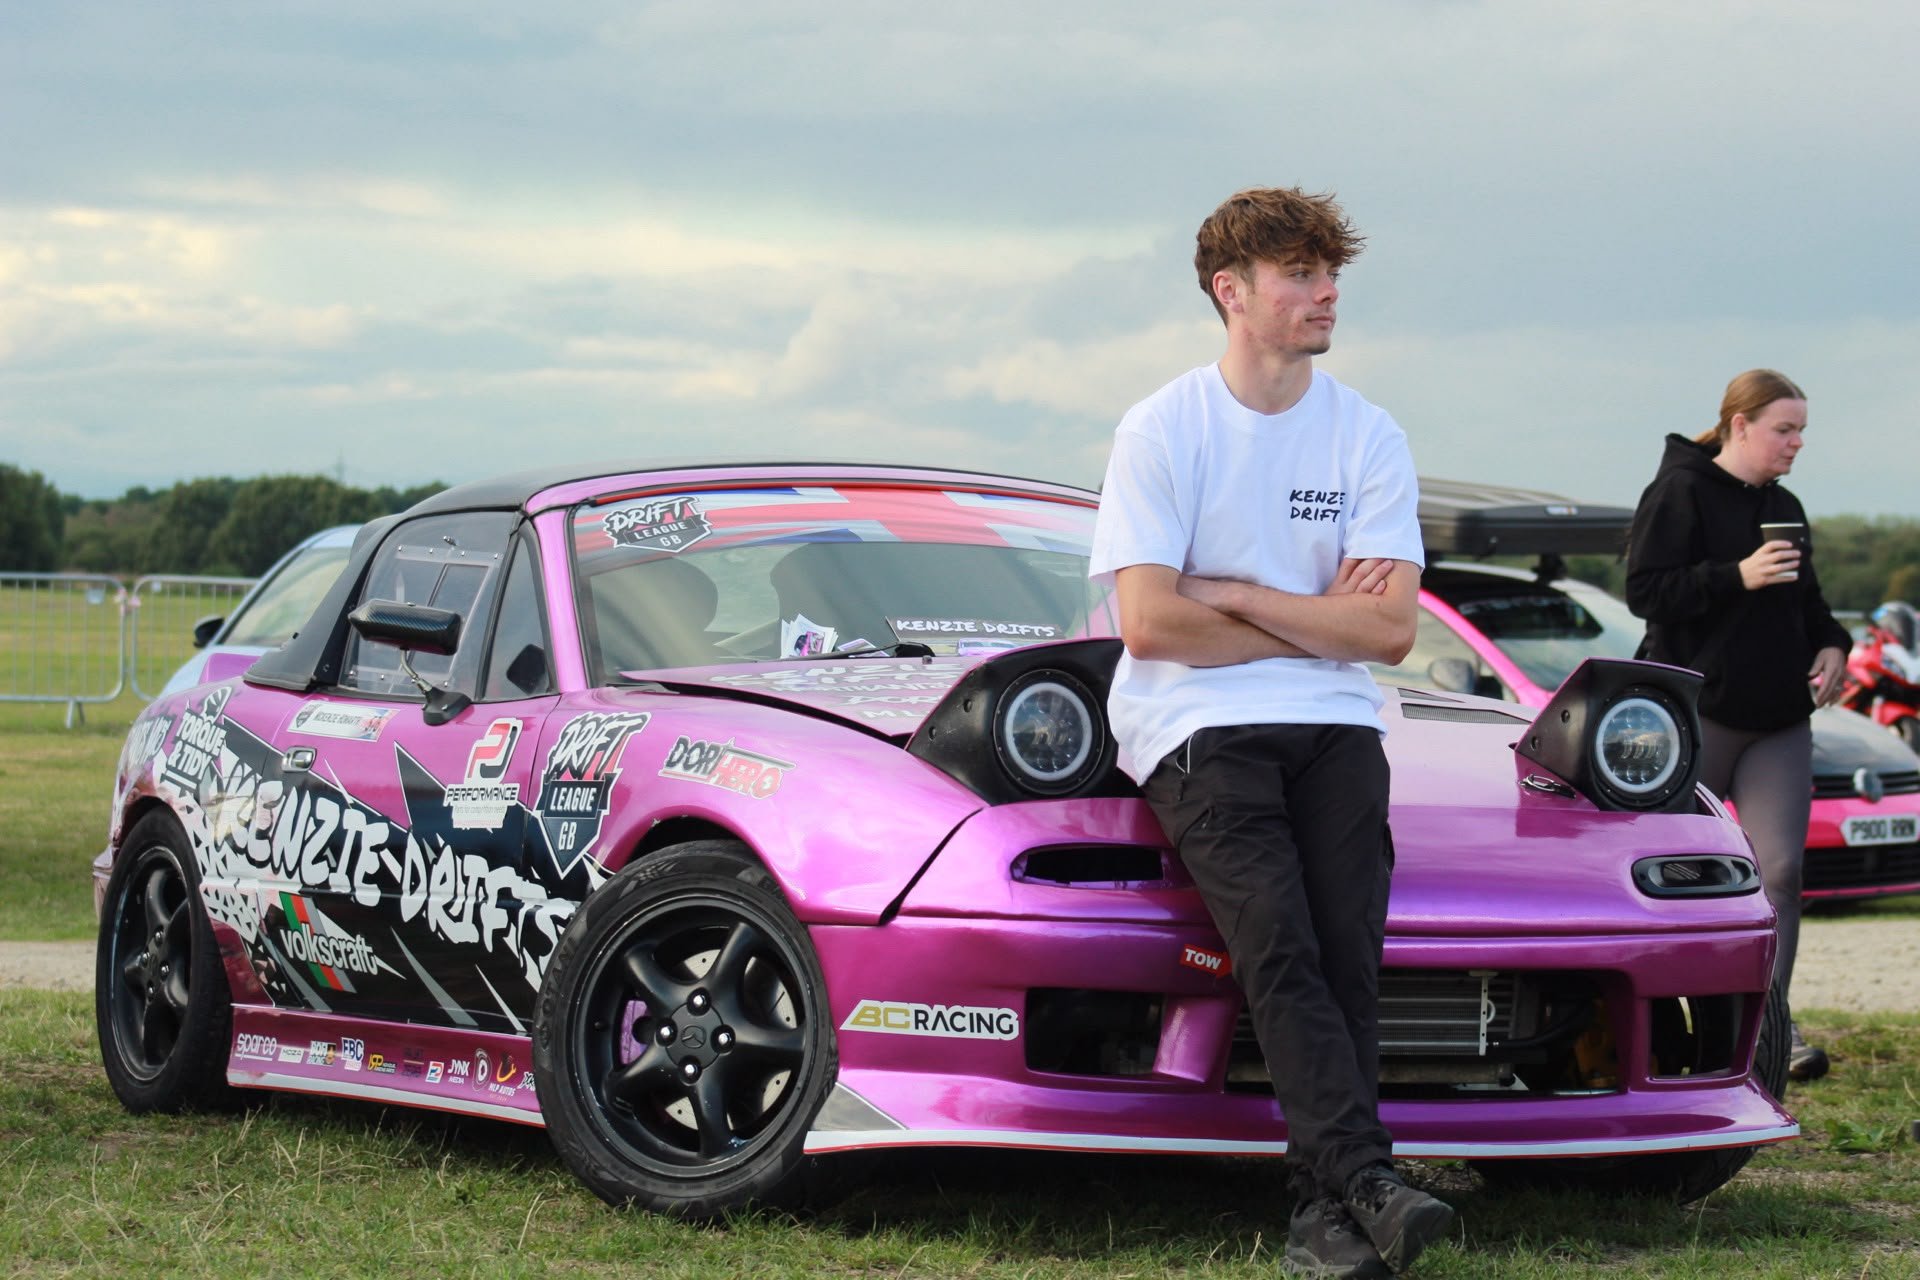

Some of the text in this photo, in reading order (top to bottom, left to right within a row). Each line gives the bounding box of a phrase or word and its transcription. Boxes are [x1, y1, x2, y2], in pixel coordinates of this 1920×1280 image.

[608, 498, 691, 534] DRIFT
[633, 521, 688, 540] LEAGUE
[660, 534, 682, 547] GB
[896, 619, 1055, 637] KENZIE DRIFTS
[176, 711, 227, 757] TORQUE
[554, 718, 642, 773] DRIFT
[179, 743, 212, 780] TIDY
[447, 786, 518, 801] PERFORMANCE
[550, 786, 597, 812] LEAGUE
[558, 821, 578, 851] GB
[279, 922, 379, 976] volkscraft
[1184, 947, 1222, 971] TOW
[850, 1008, 1015, 1036] BC RACING
[236, 1032, 278, 1060] sparco
[343, 1038, 364, 1061] EBC
[447, 1058, 471, 1077] JYNX
